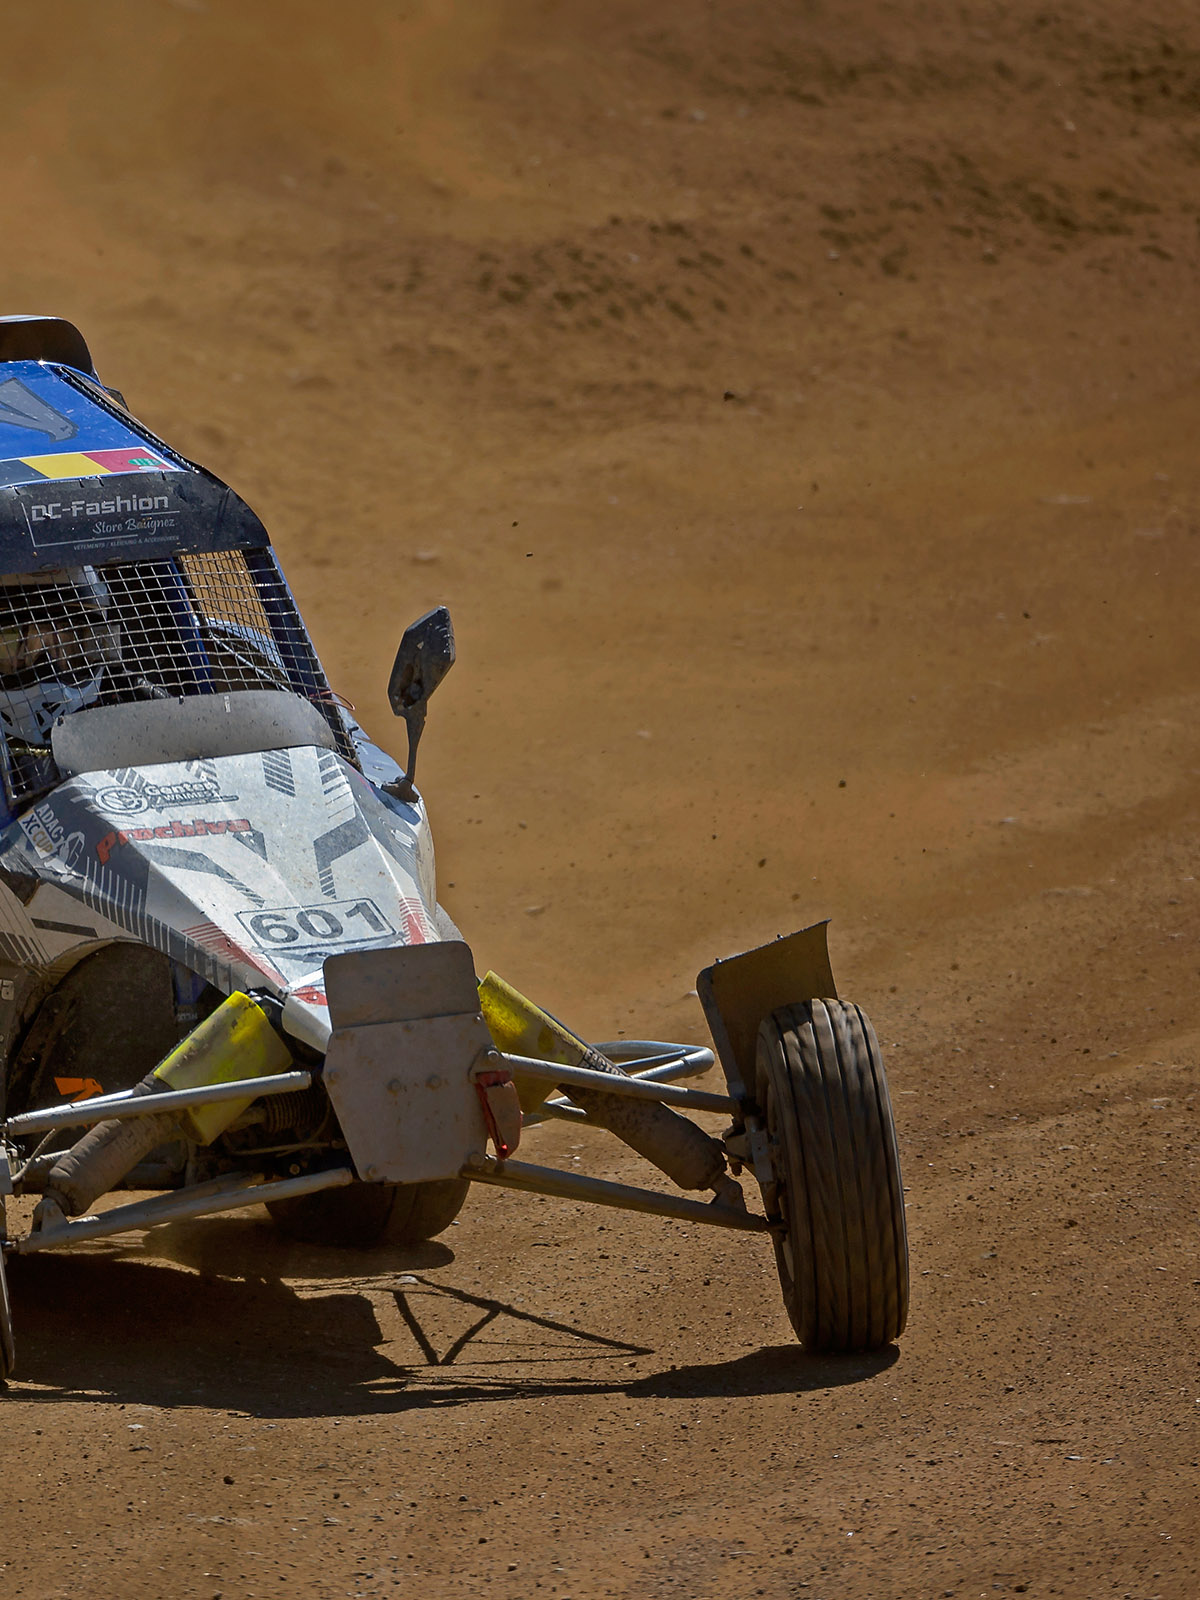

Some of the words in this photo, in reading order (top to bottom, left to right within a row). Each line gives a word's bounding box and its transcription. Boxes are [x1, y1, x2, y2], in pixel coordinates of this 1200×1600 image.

[31, 494, 169, 521] DC-Fashion
[92, 521, 122, 534] Store
[125, 518, 176, 535] Baugnez
[36, 803, 64, 839] ADAC
[249, 901, 387, 944] 601
